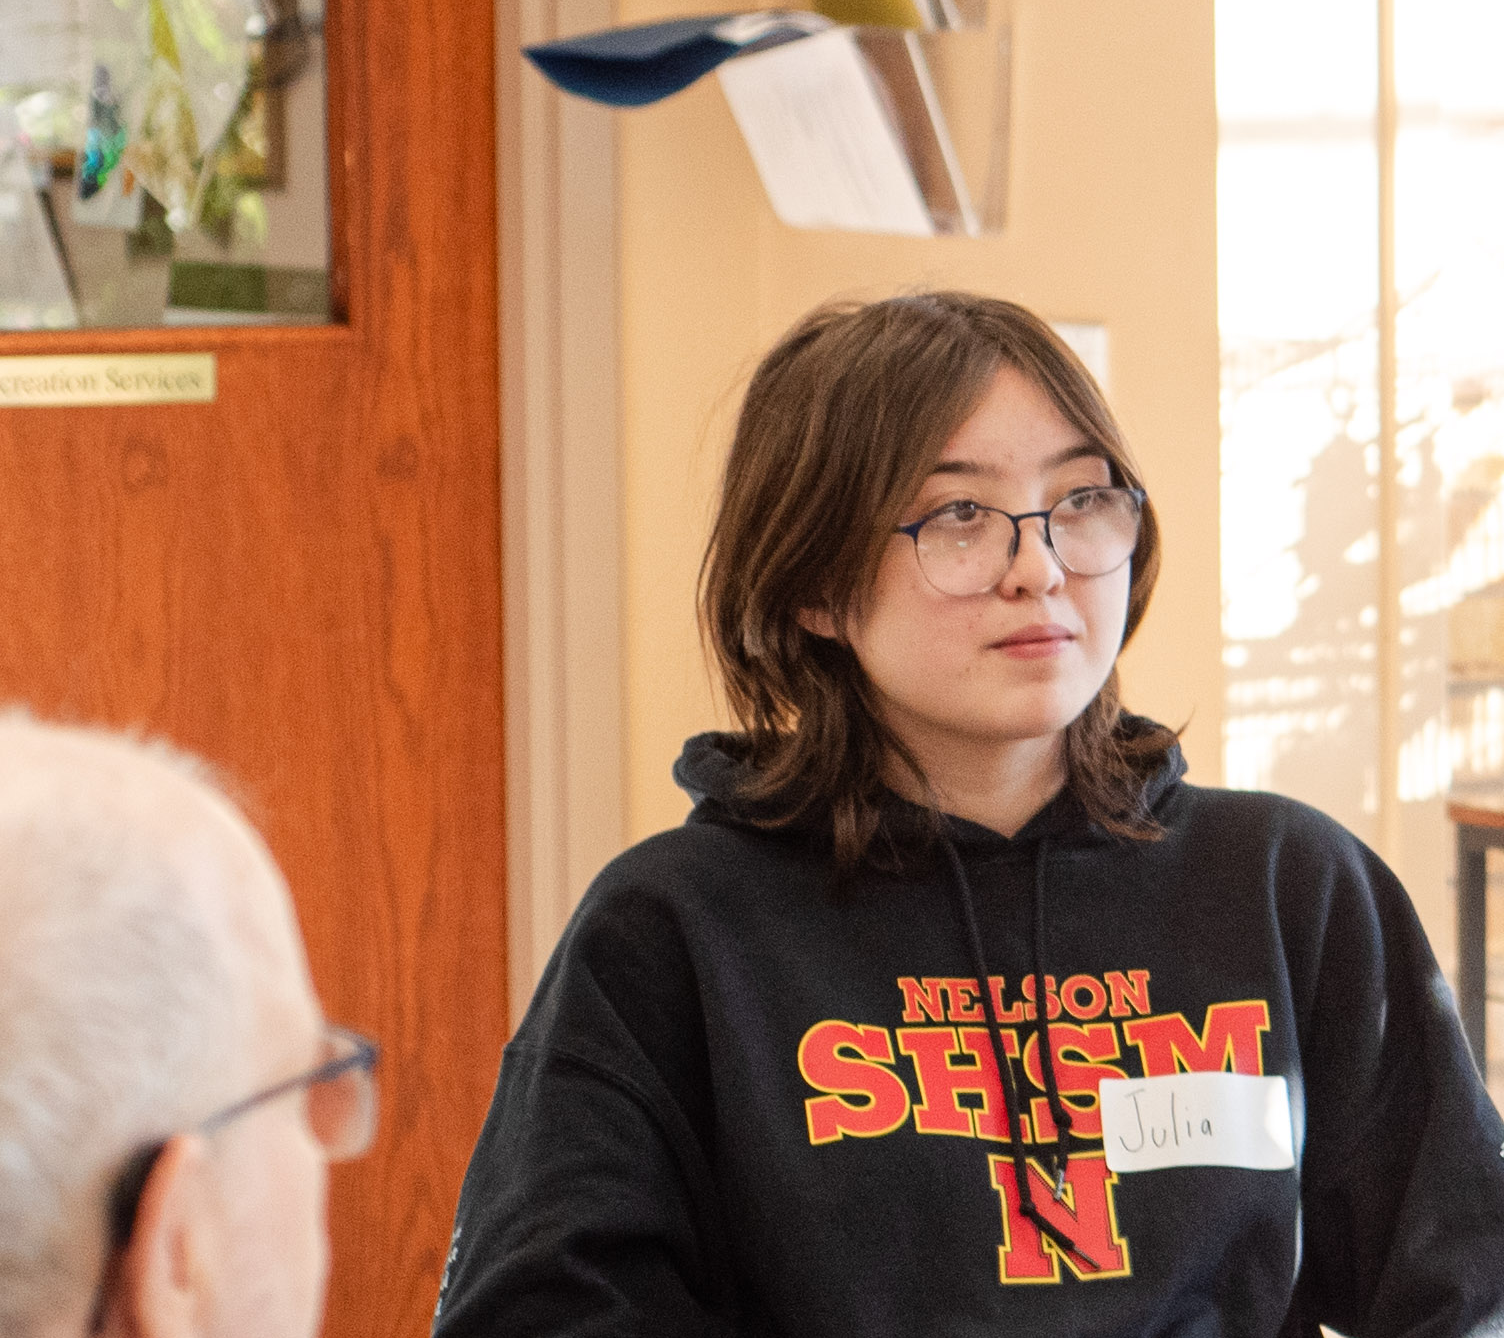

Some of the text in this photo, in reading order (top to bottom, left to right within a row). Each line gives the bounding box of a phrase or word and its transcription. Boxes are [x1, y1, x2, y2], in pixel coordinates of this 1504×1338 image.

[104, 365, 201, 394] Services
[897, 970, 1152, 1023] NELSON
[1119, 1088, 1213, 1153] Julia
[987, 1151, 1133, 1285] N
